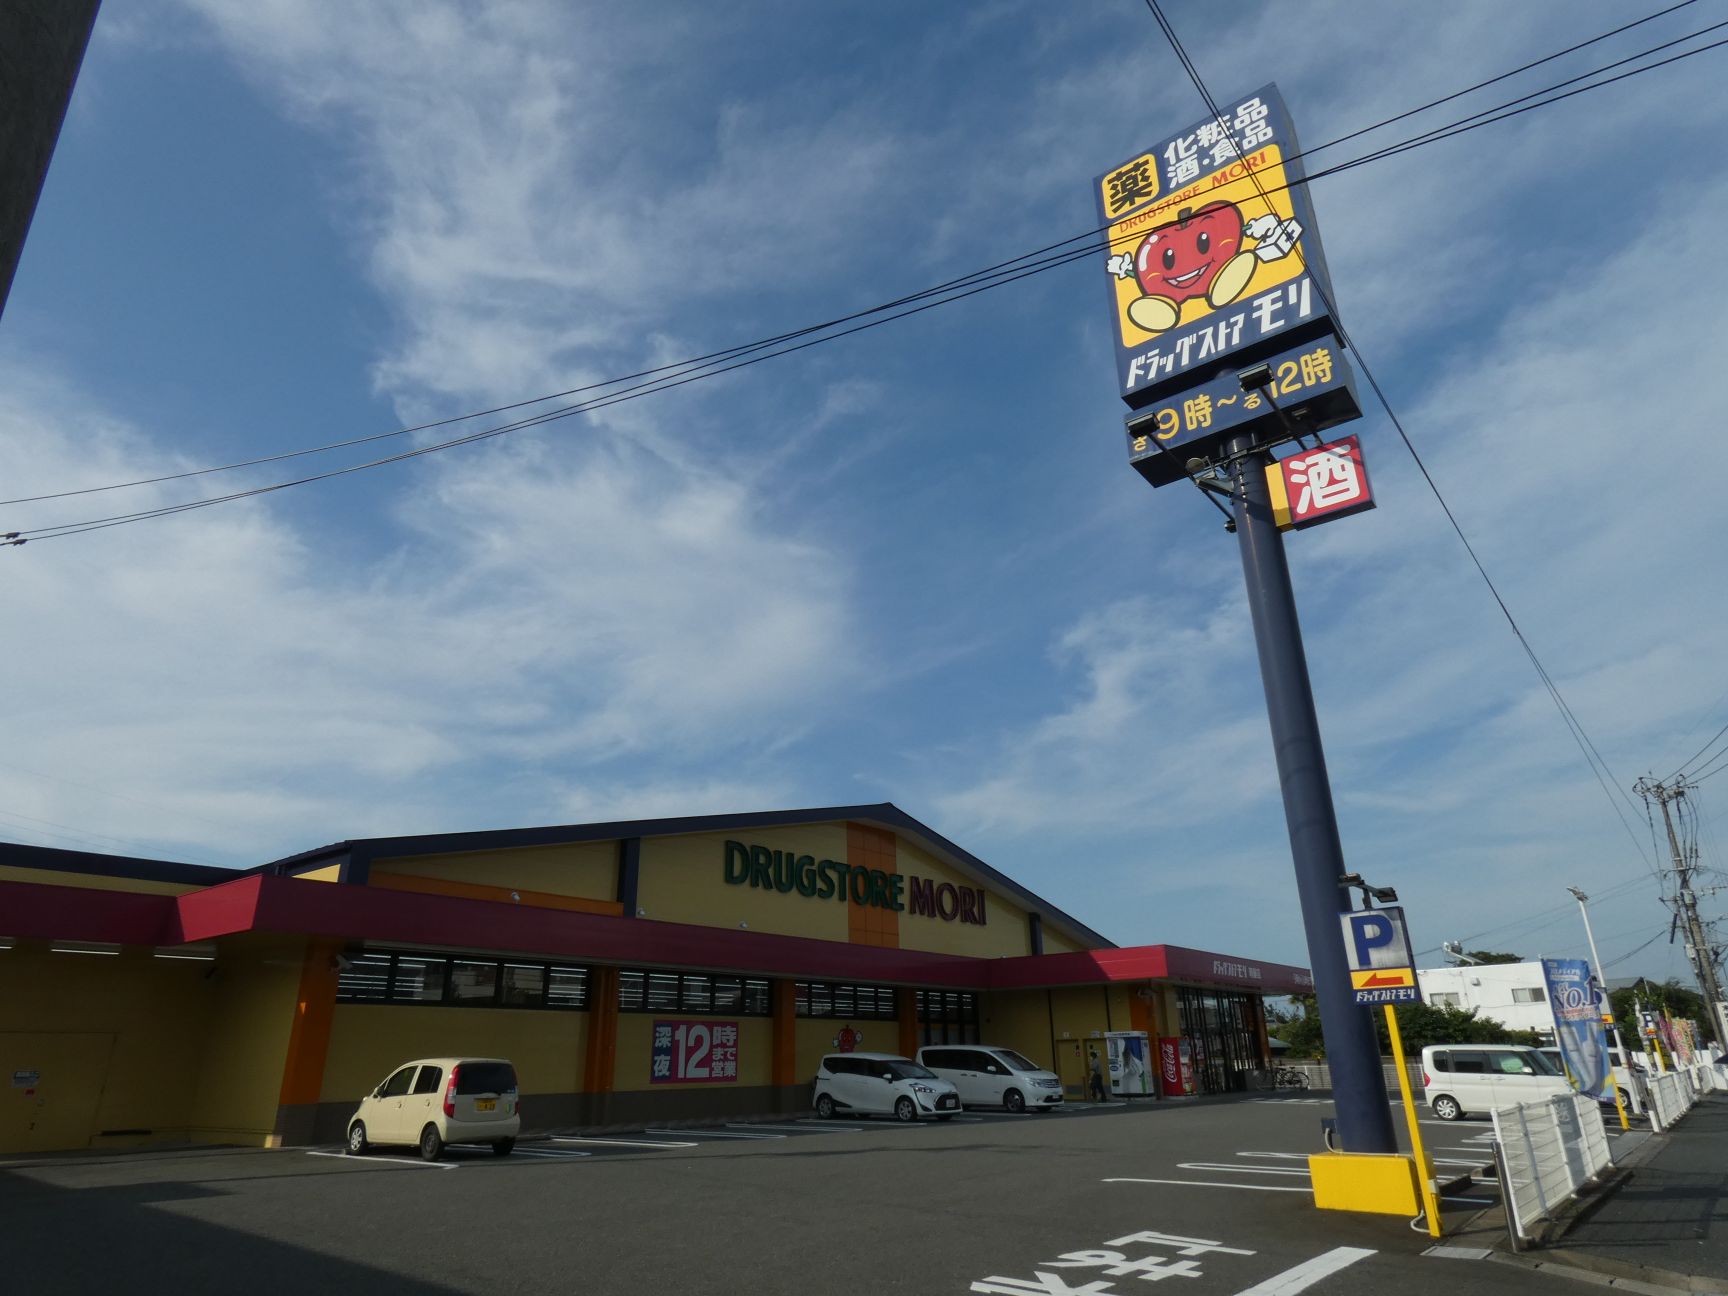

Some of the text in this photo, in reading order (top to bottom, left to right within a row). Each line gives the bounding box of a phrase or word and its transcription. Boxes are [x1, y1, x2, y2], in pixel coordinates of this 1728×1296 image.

[1163, 97, 1268, 163] 化粧品
[1169, 119, 1274, 188] 酒・食品
[1107, 159, 1153, 214] 薬
[1119, 151, 1267, 233] DRUGSTORE MORI
[1289, 444, 1361, 514] 酒
[724, 839, 987, 926] DRUGSTORE MORI
[1350, 914, 1395, 966] P
[654, 1026, 673, 1077] 深夜
[675, 1024, 711, 1079] 12
